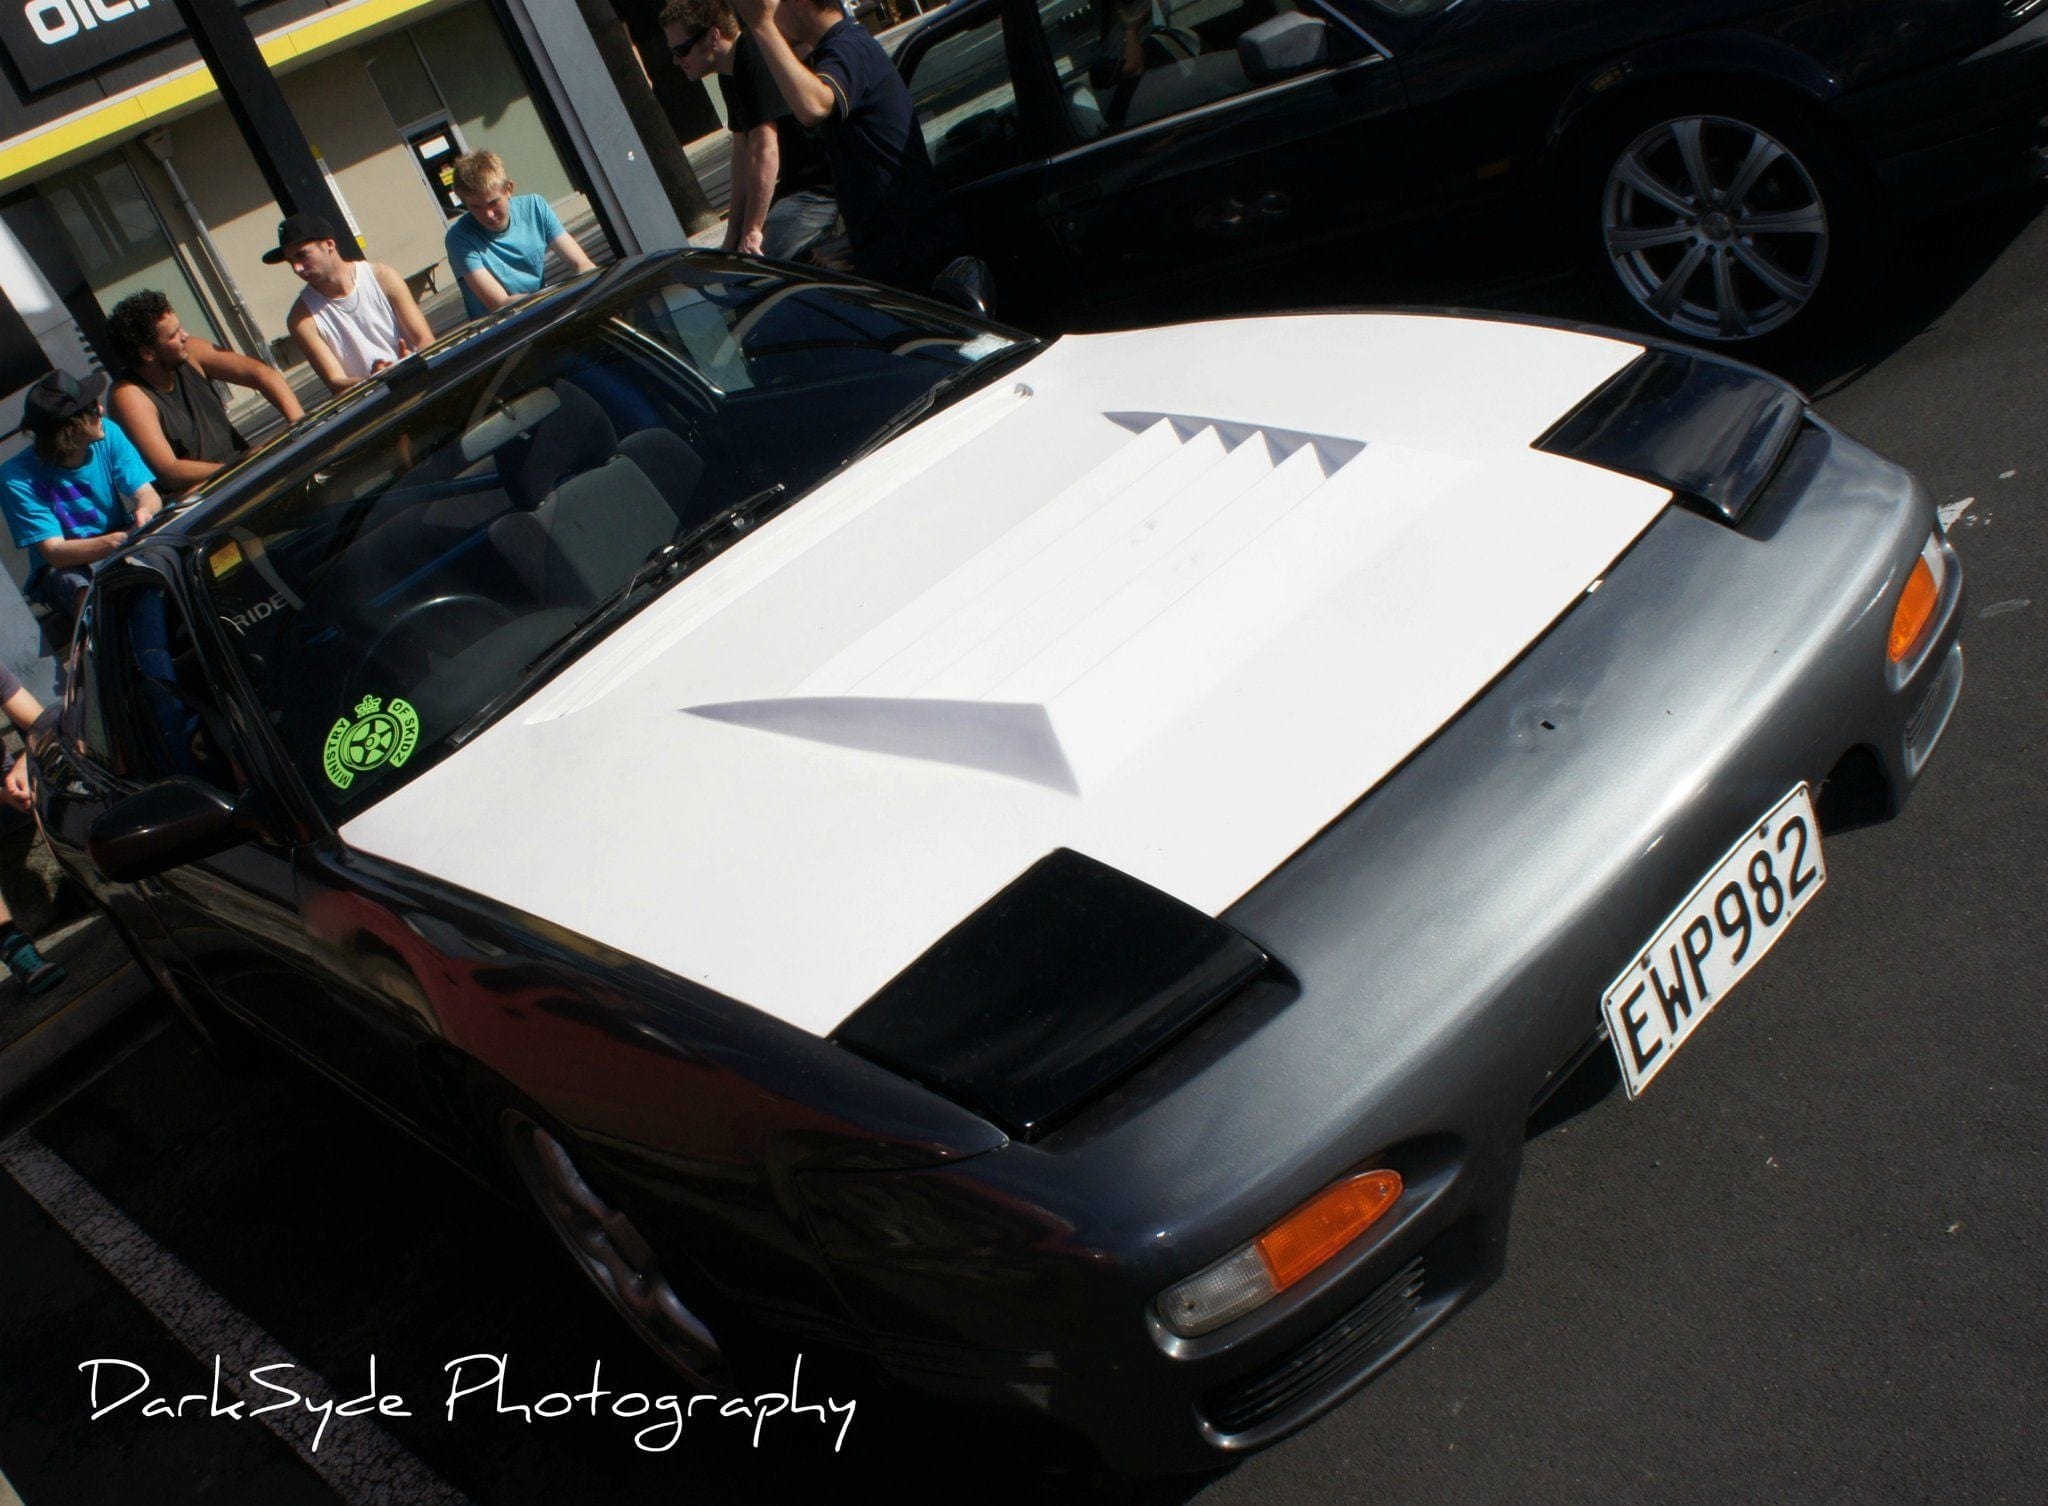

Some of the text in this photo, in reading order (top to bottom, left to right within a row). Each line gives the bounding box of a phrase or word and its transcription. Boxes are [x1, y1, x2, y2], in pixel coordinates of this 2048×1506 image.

[326, 720, 351, 786] MINISTRY
[392, 702, 415, 763] OF SKIDZ
[1619, 815, 1816, 1074] EWP982
